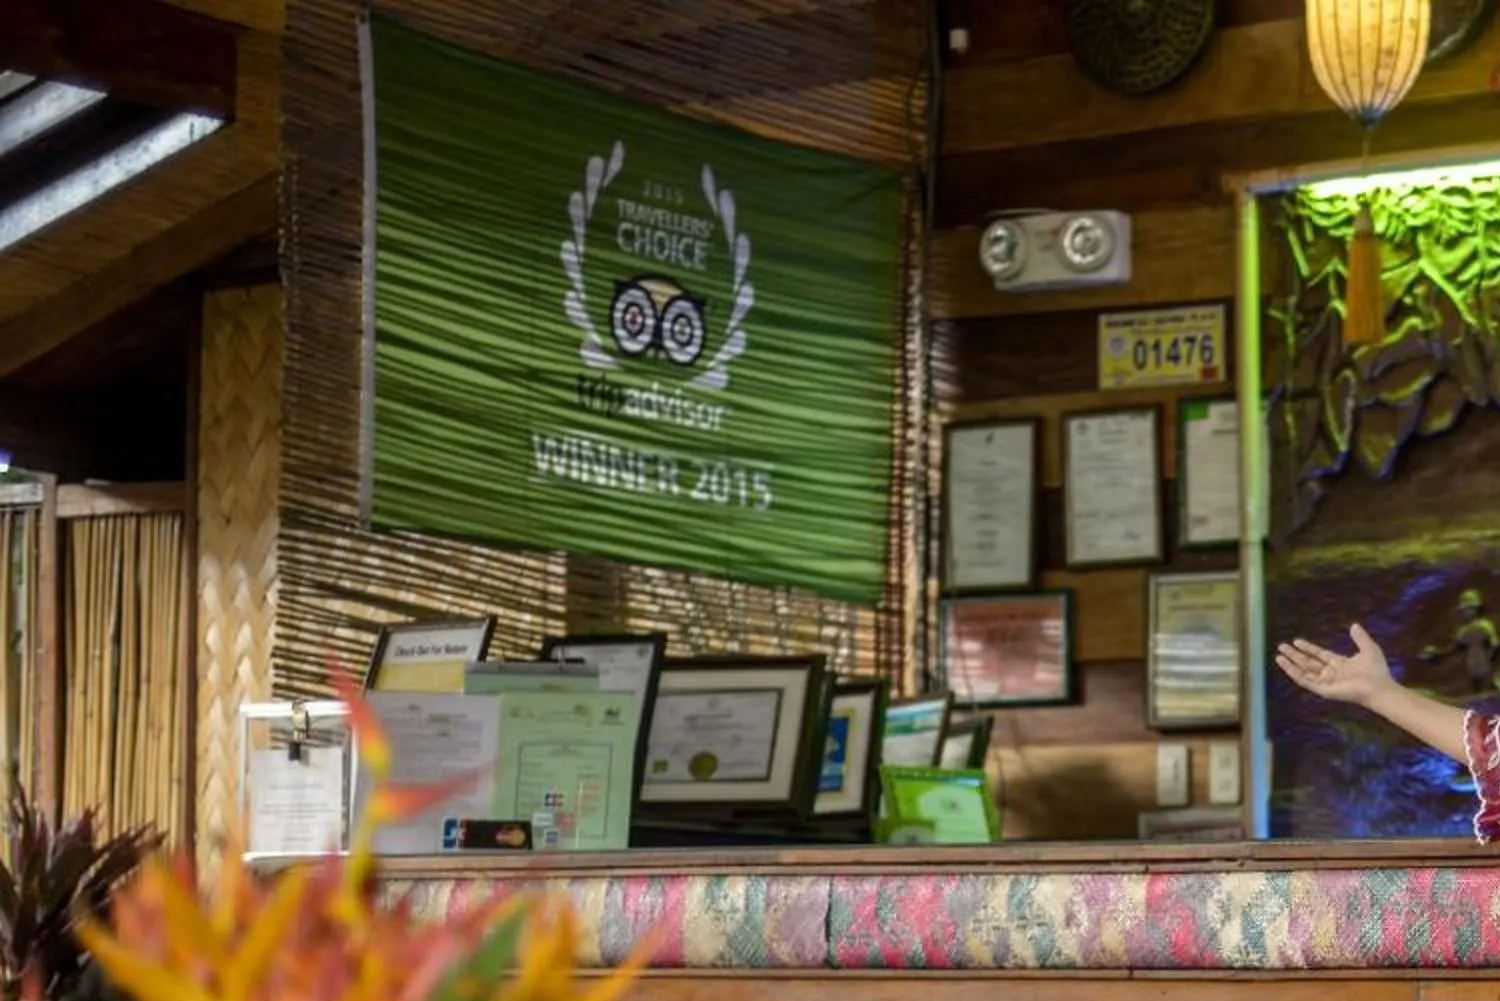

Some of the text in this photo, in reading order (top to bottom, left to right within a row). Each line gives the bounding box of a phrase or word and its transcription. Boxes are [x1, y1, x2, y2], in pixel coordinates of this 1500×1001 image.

[616, 222, 707, 271] CHOICE
[1133, 334, 1214, 372] 01476
[532, 434, 774, 513] WINNER 2015
